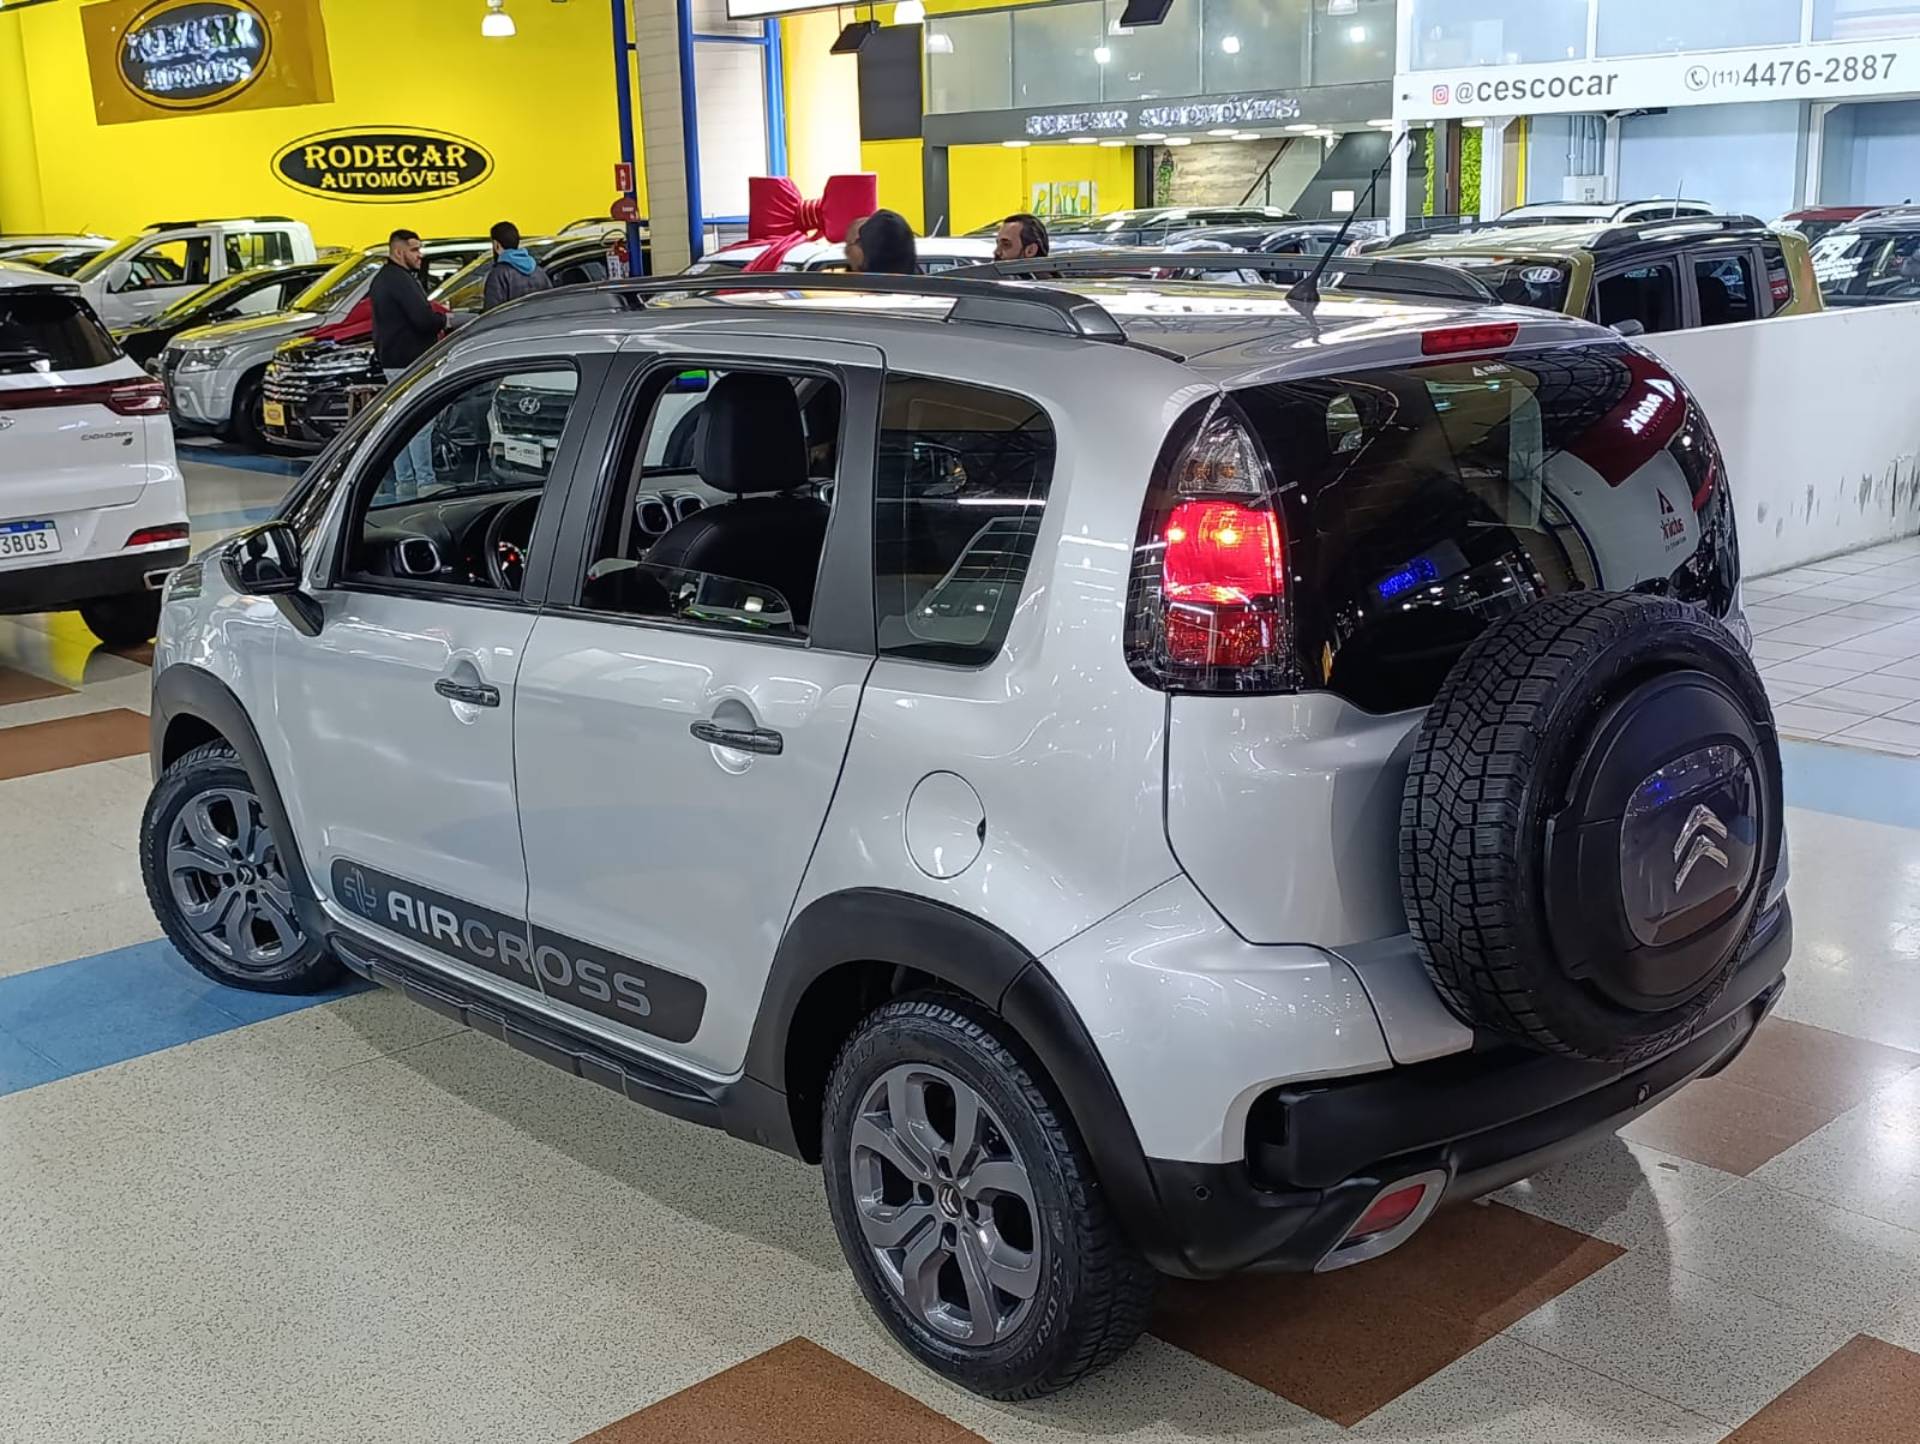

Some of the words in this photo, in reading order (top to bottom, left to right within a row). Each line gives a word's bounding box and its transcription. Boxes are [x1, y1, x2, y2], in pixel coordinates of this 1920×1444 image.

[1712, 70, 1740, 88] (11)
[1742, 53, 1898, 88] 4476-2887
[1455, 73, 1619, 105] @cescocar
[304, 144, 467, 171] RODECAR
[320, 168, 461, 189] AUTOMÓVEIS
[0, 532, 48, 554] 3B03
[387, 890, 652, 1017] AIRCROSS
